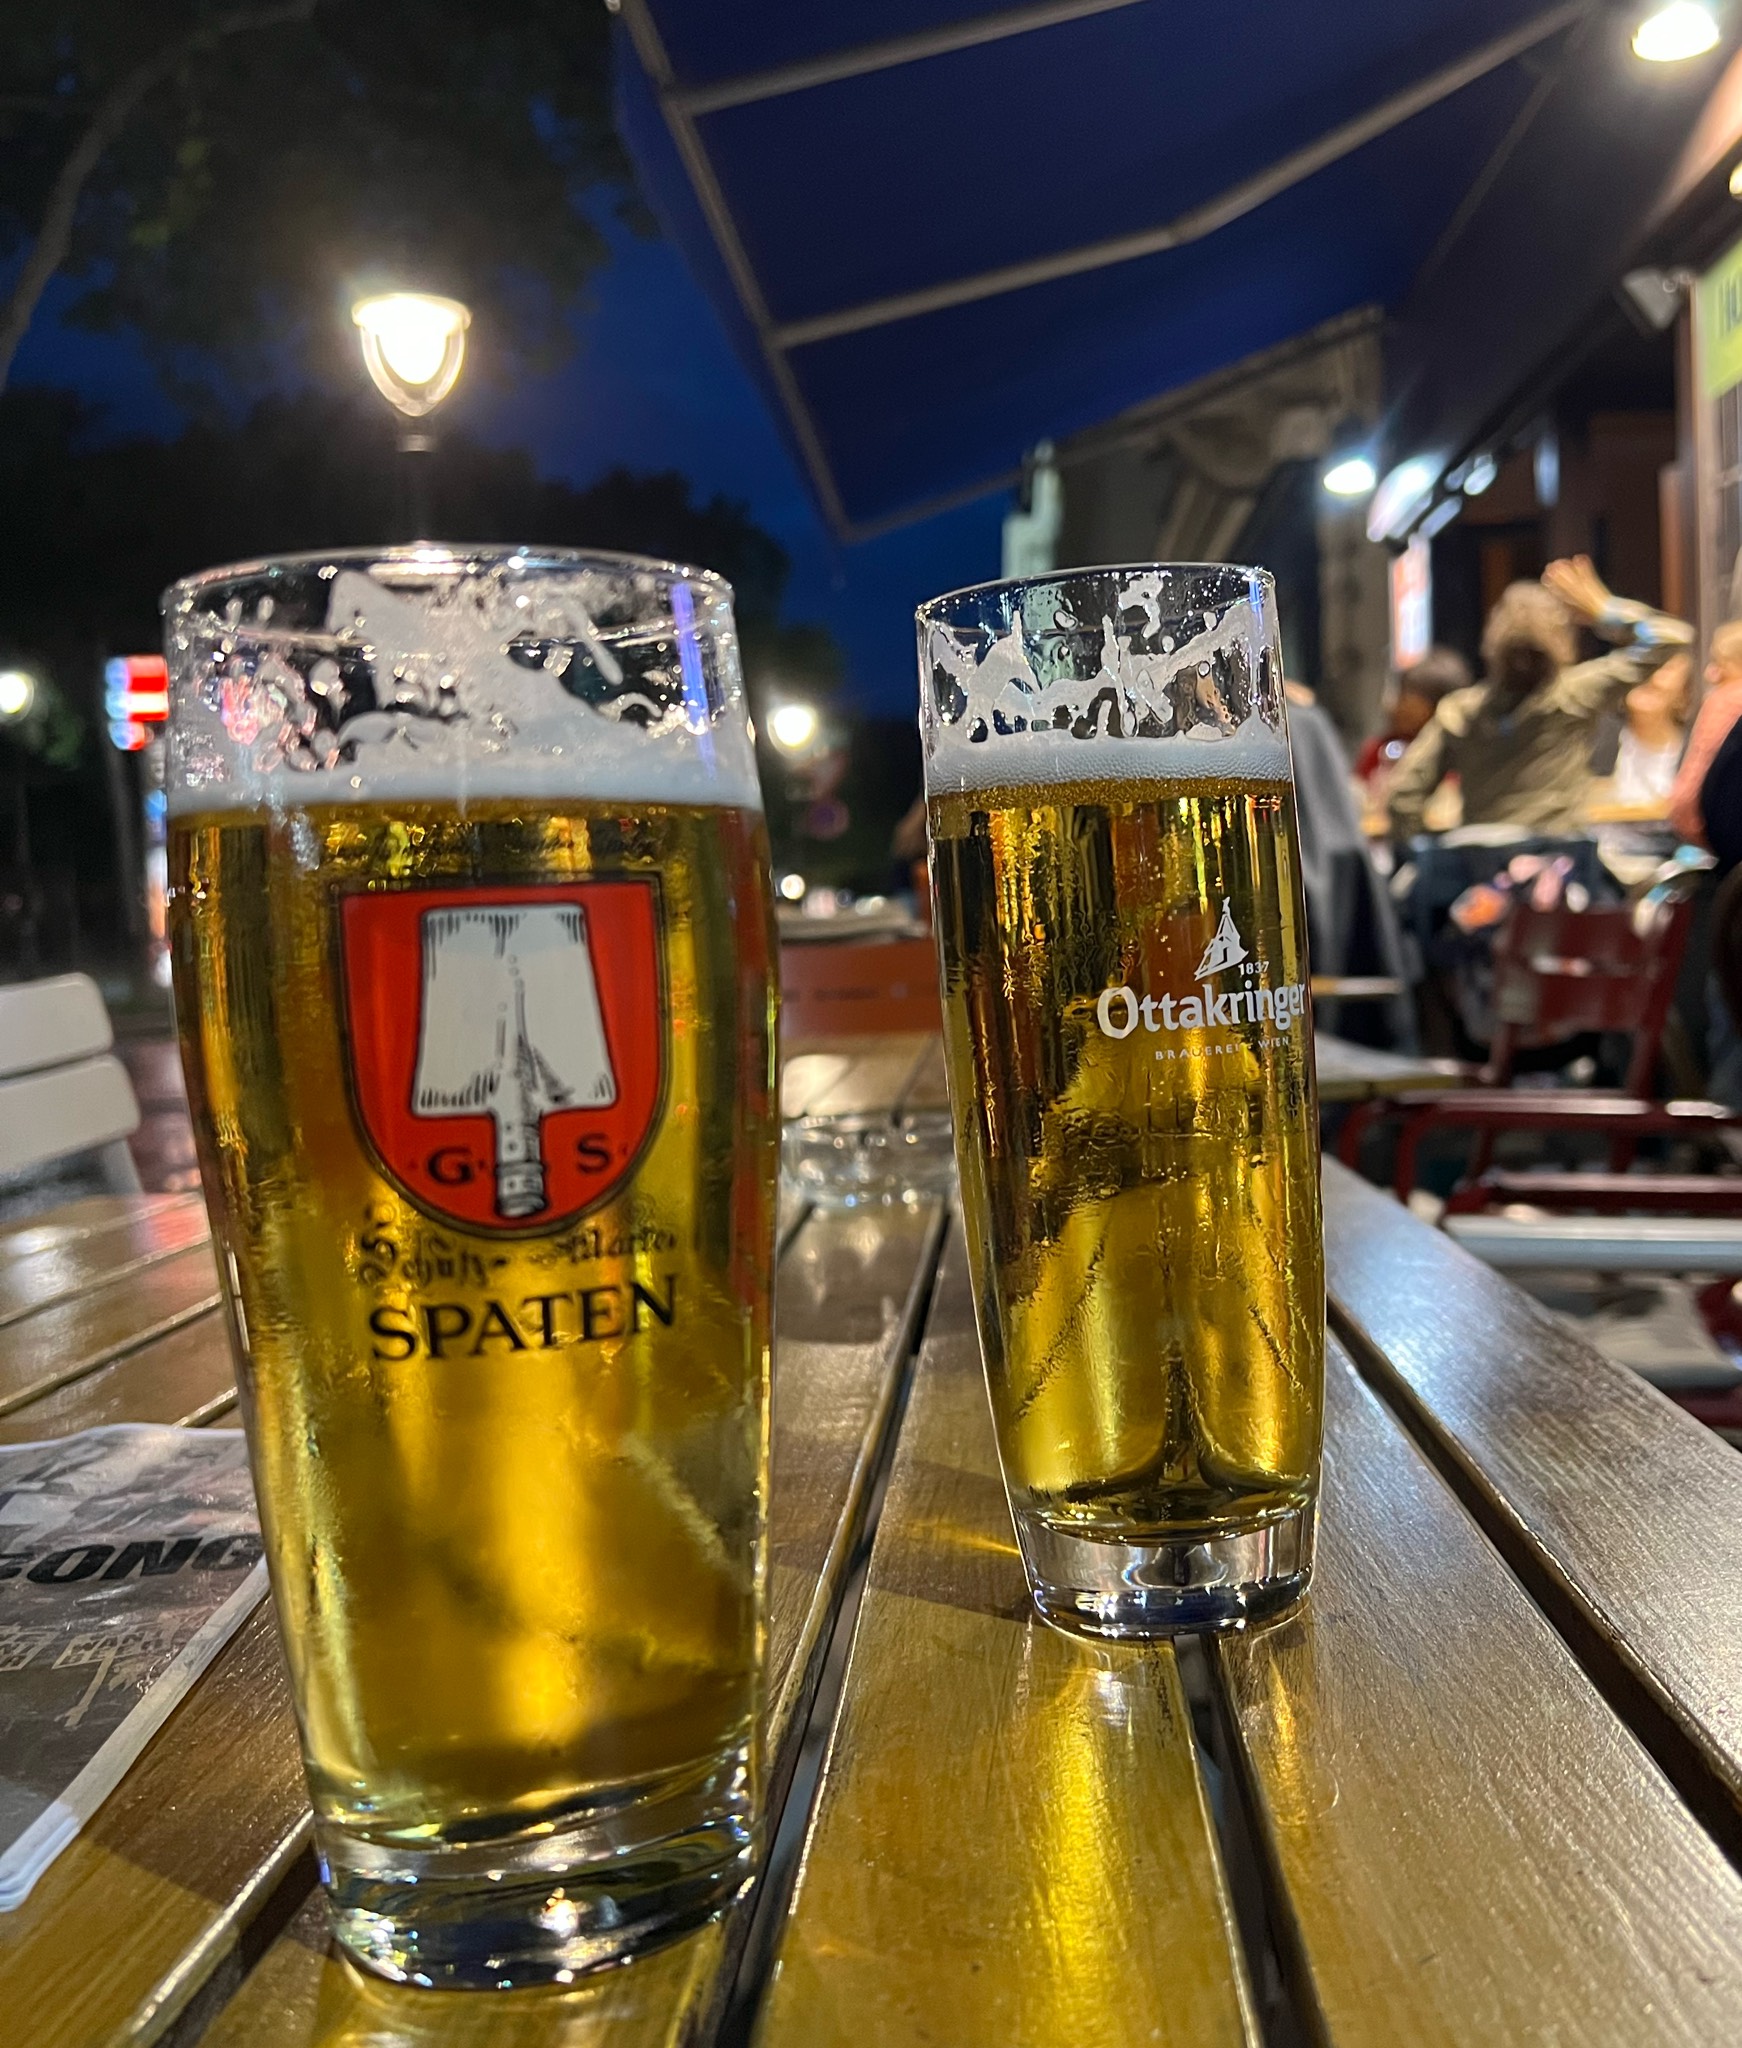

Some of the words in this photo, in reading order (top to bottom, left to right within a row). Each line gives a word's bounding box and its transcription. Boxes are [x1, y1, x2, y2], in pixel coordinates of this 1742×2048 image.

[1238, 961, 1270, 978] 1837
[1097, 980, 1305, 1040] Ottakringer
[1155, 1043, 1240, 1061] BRAUEREI
[1258, 1036, 1290, 1050] WIEN
[427, 1147, 474, 1186] G
[577, 1132, 613, 1176] S
[368, 1274, 679, 1364] SPATEN
